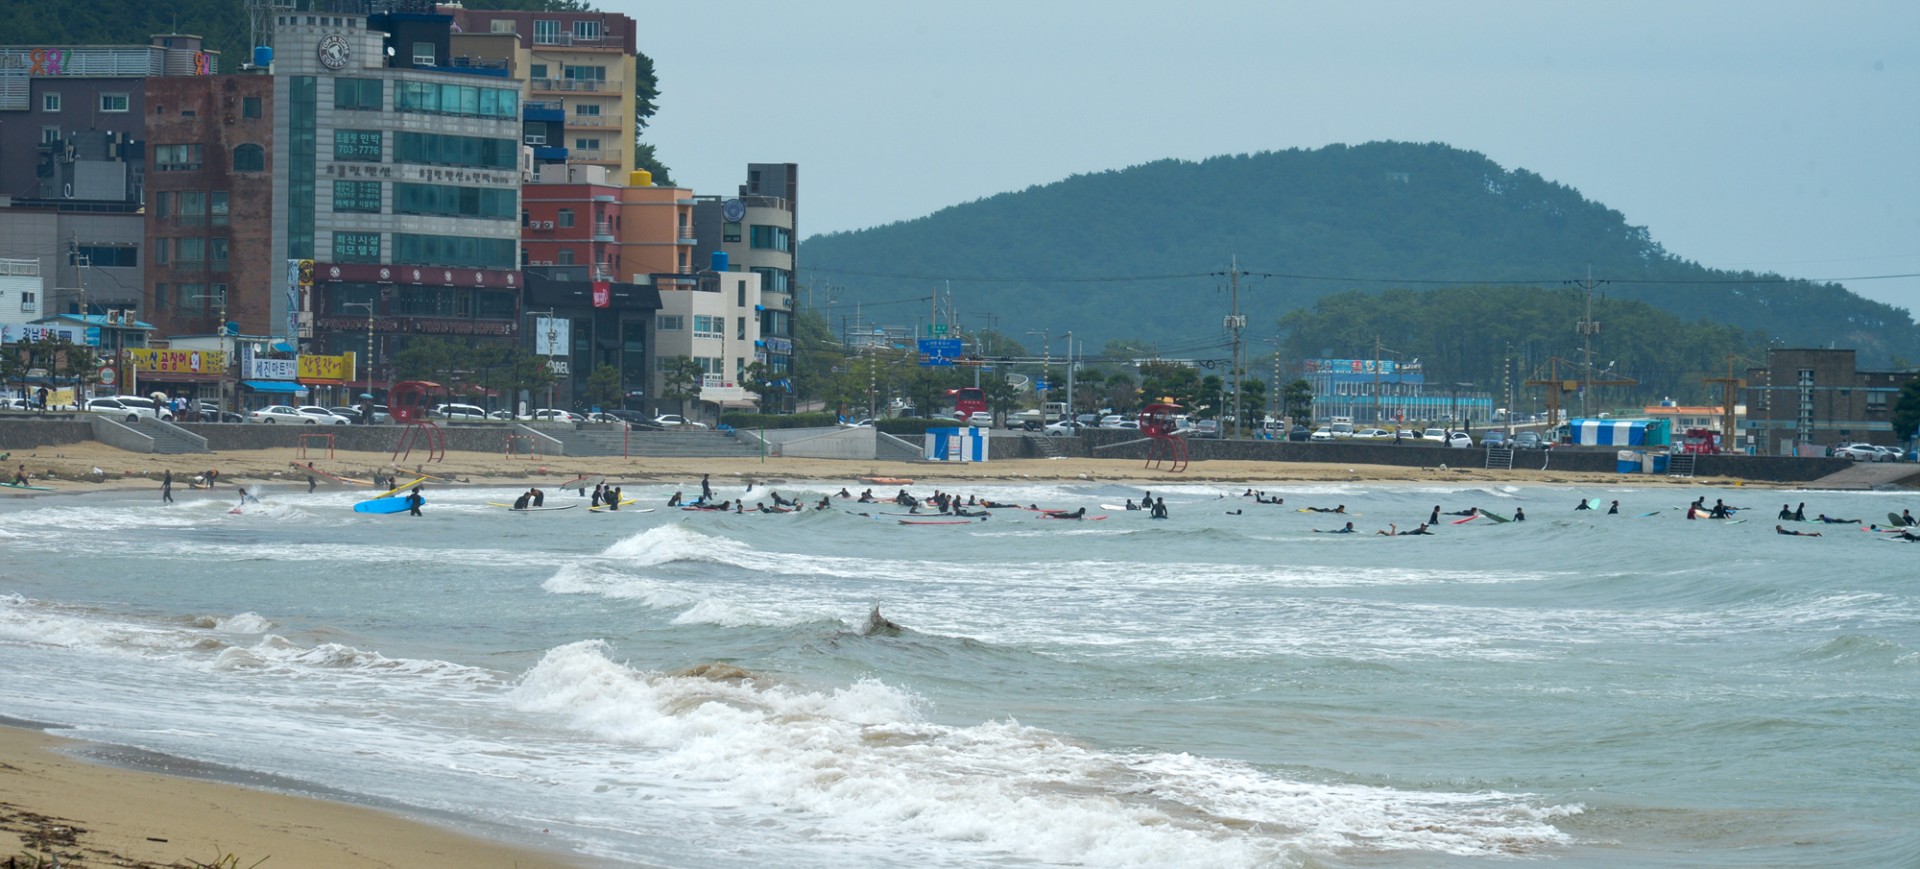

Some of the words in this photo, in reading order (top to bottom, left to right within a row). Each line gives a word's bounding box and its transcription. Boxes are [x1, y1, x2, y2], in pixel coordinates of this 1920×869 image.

[322, 54, 347, 68] COFFEE
[360, 133, 379, 144] 민박
[338, 145, 379, 155] 703-7776
[255, 361, 286, 378] 세진마트
[401, 410, 407, 418] 2
